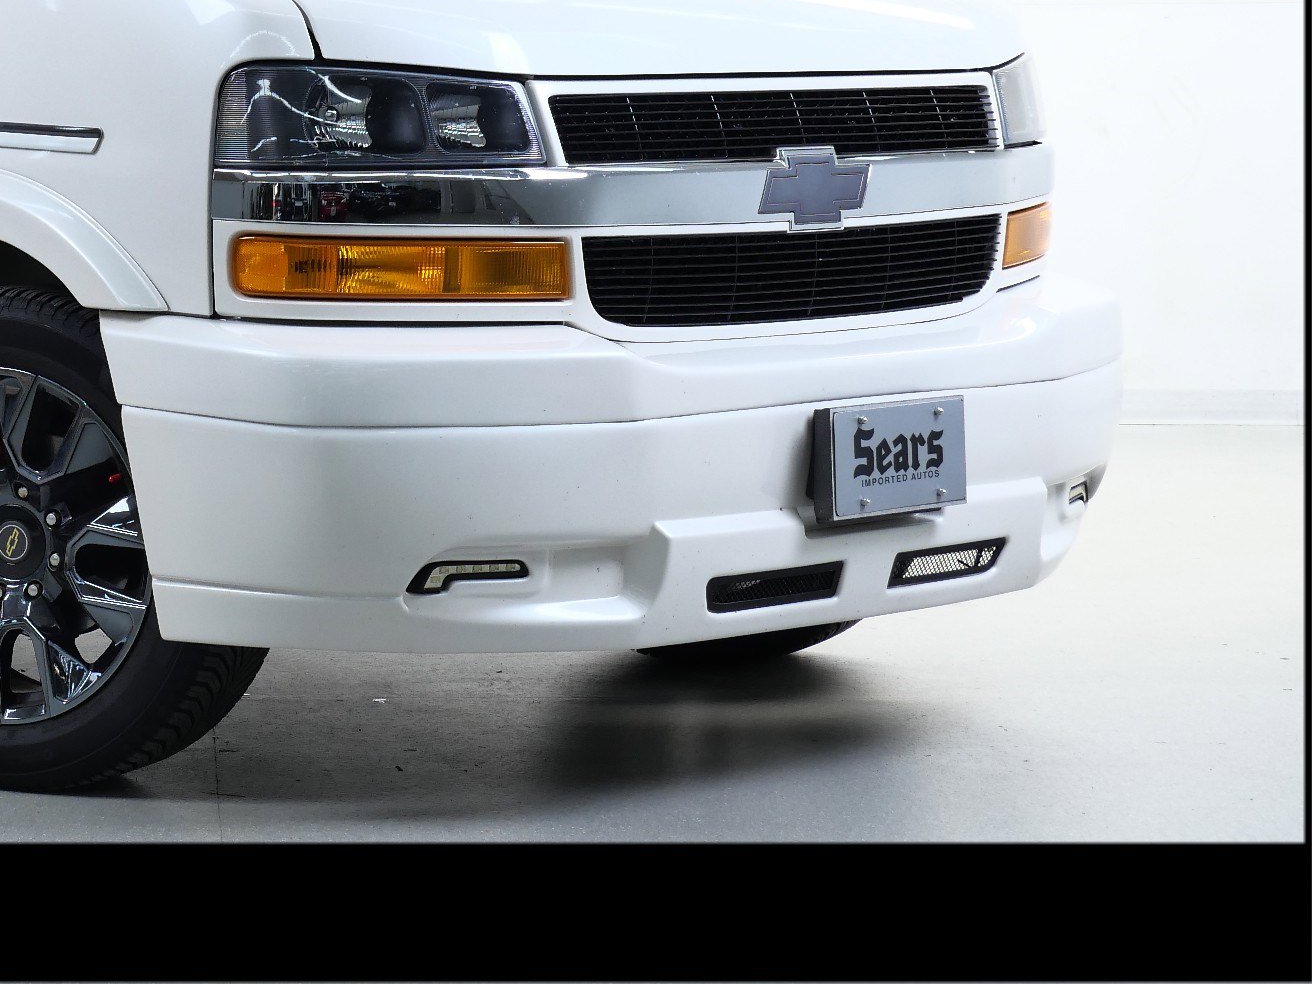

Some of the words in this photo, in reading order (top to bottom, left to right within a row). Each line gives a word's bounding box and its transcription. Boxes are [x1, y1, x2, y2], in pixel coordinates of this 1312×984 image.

[853, 427, 944, 479] Sears
[861, 474, 908, 487] IMPORTED
[910, 469, 940, 481] AUTOS
